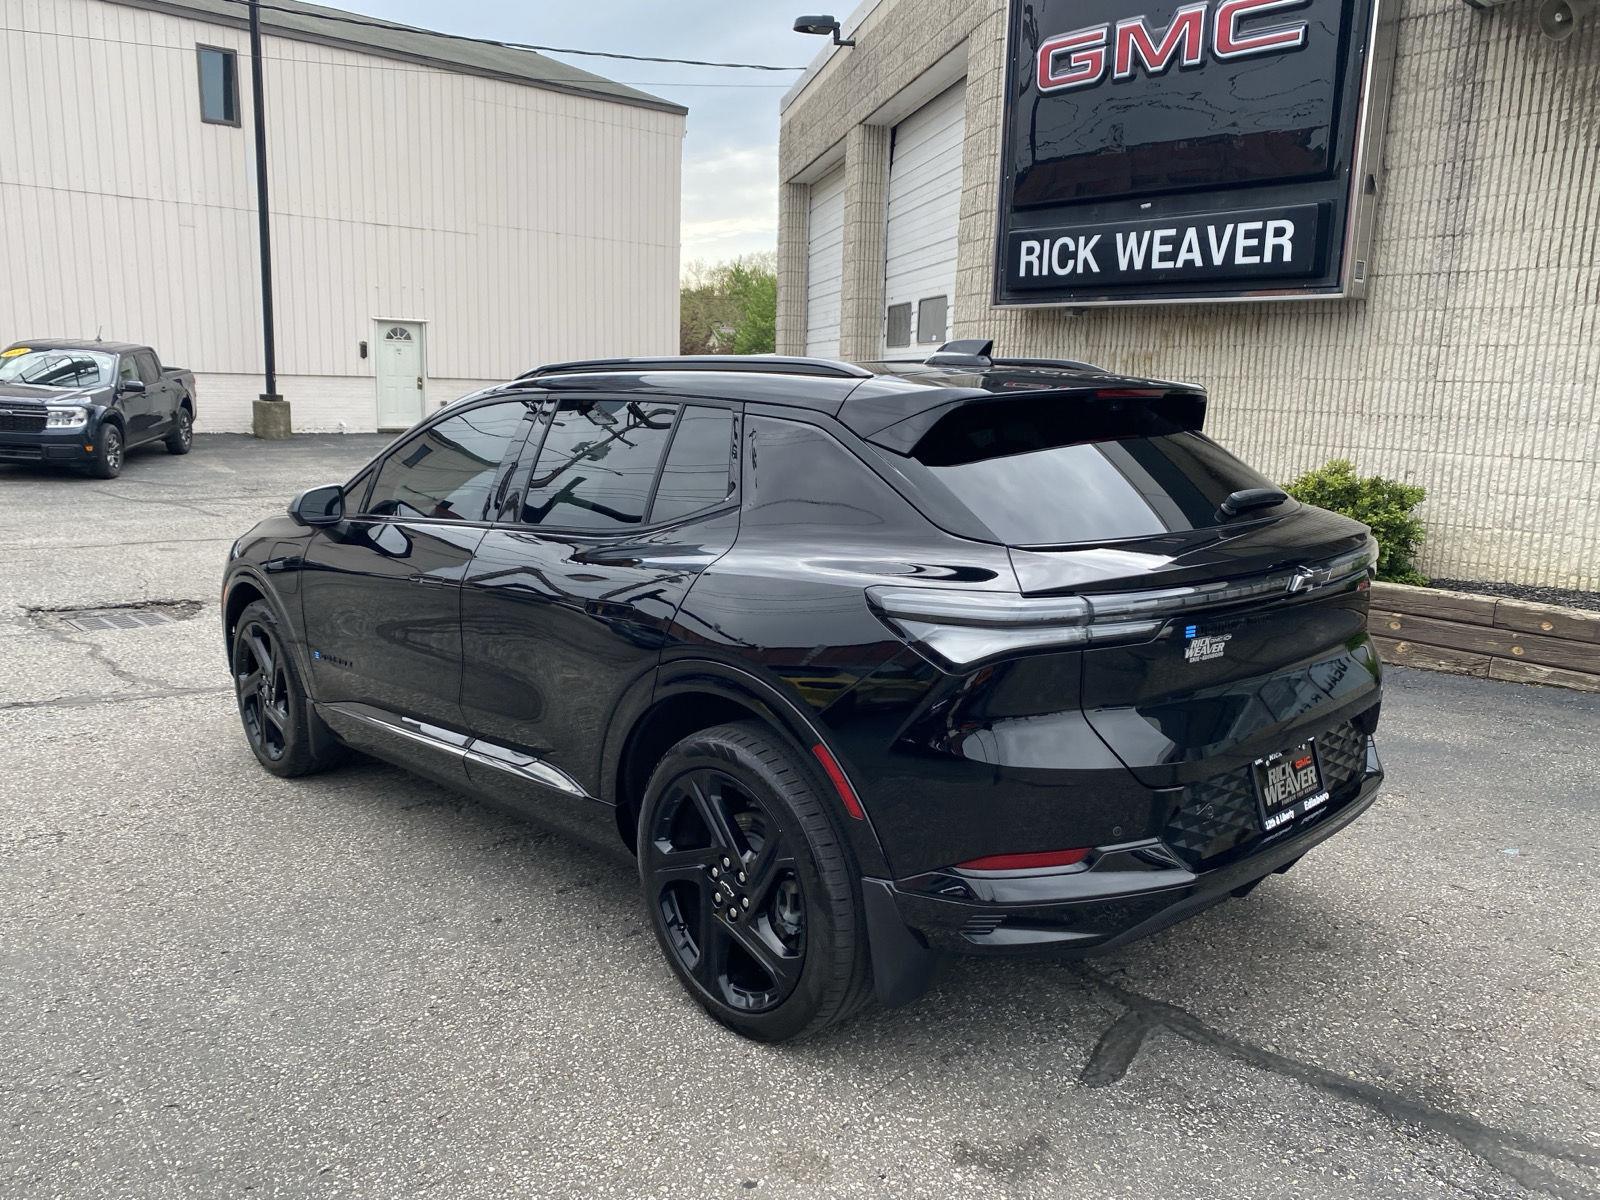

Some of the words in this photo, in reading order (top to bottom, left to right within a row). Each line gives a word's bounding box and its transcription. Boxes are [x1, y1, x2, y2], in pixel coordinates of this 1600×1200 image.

[1036, 0, 1308, 94] GMC
[1019, 234, 1102, 277] RICK
[1115, 219, 1295, 272] WEAVER
[1184, 642, 1225, 659] WEAVER
[1190, 637, 1211, 649] RICK
[1264, 765, 1317, 807] WEAVER
[1267, 761, 1294, 786] RICK
[1295, 755, 1312, 769] GMC
